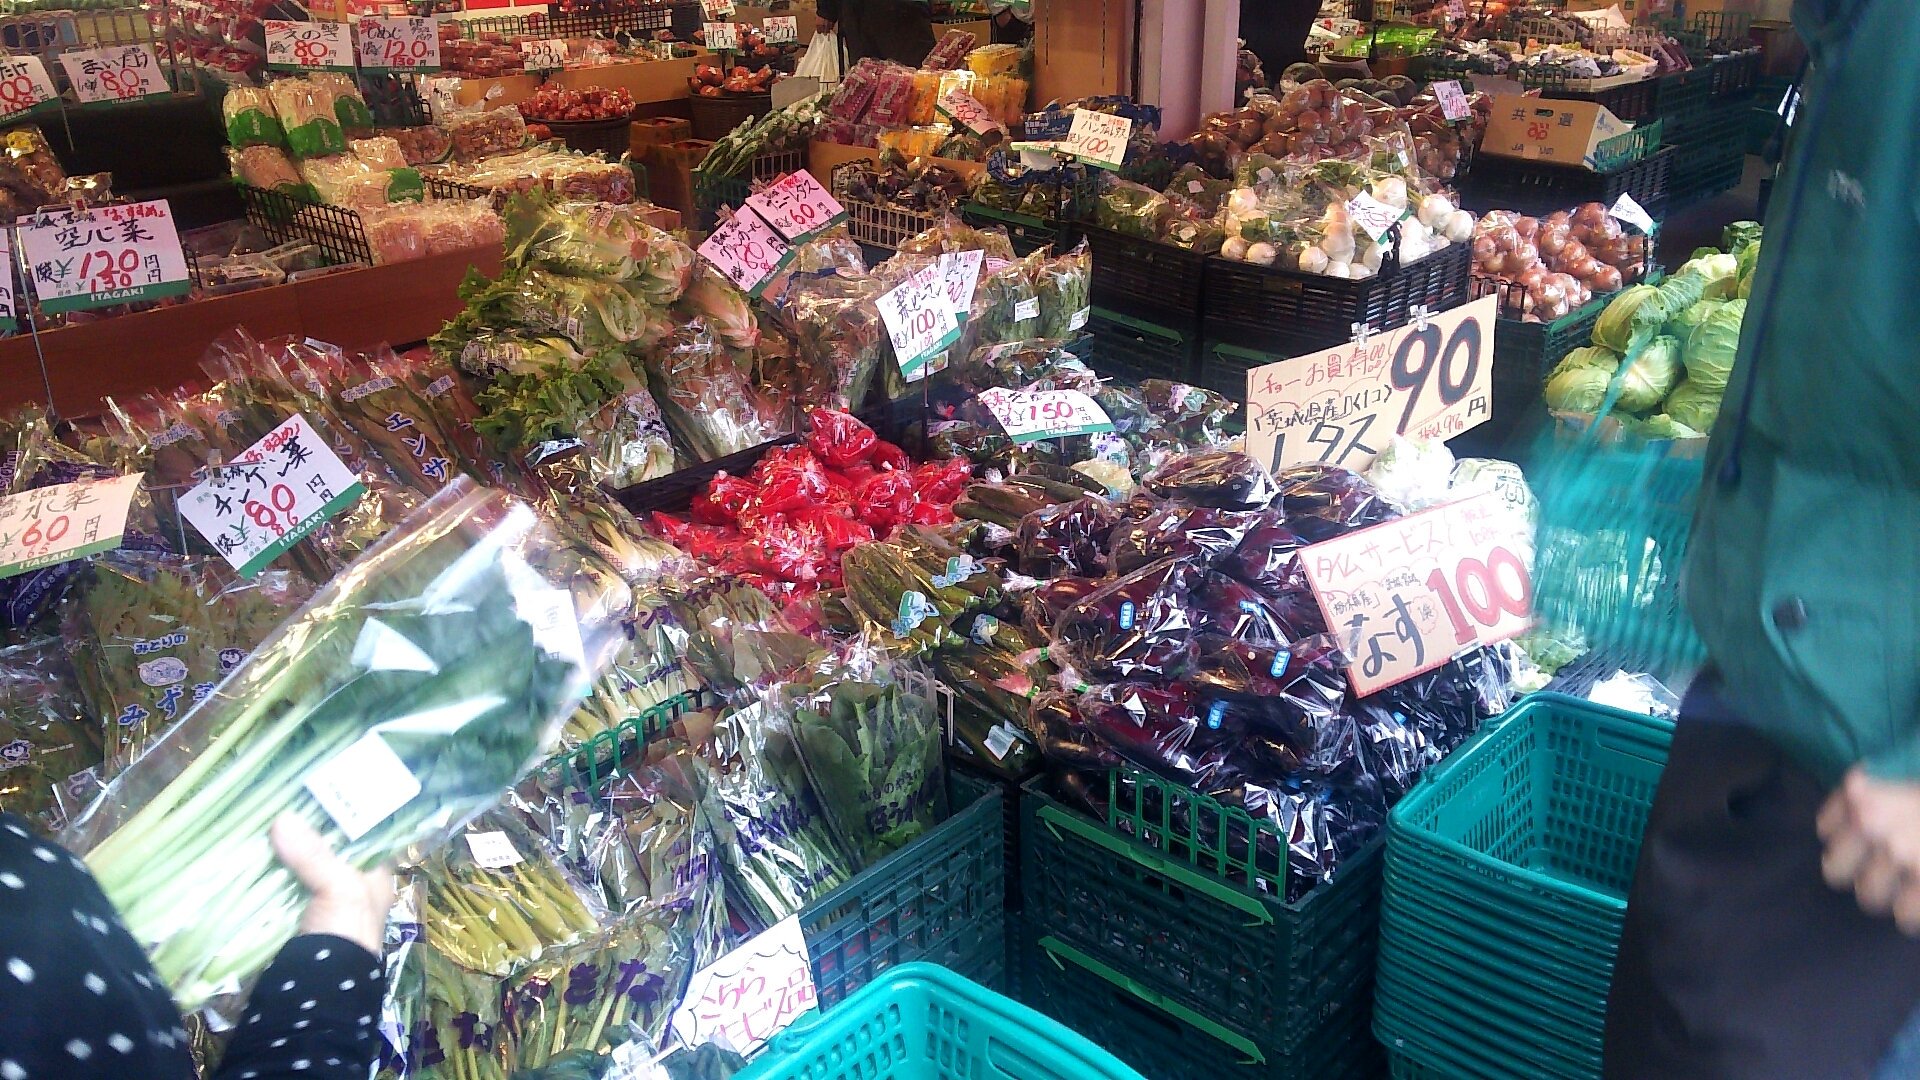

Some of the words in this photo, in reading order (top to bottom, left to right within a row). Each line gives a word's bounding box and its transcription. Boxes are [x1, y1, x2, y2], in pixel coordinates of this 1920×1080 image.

[294, 40, 328, 58] 80
[384, 40, 428, 59] 120
[82, 54, 148, 75] まいたけ
[100, 68, 140, 91] 80
[1079, 136, 1109, 153] 100
[789, 203, 815, 225] 60
[54, 218, 154, 251] 空心菜
[79, 249, 139, 279] 120
[90, 287, 144, 302] ITAGAKI
[91, 273, 133, 293] 130
[911, 308, 936, 340] 100
[1391, 316, 1482, 436] 90
[1467, 396, 1487, 417] 円
[1029, 401, 1074, 421] 150
[213, 435, 313, 517] チンゲン菜
[20, 484, 101, 521] 水菜
[244, 483, 296, 527] 80
[21, 515, 70, 547] 60
[279, 510, 325, 547] ITAGAKI
[20, 550, 75, 570] ITAGAKI
[26, 542, 51, 558] 65
[1425, 545, 1534, 646] 100
[1342, 593, 1426, 679] なす
